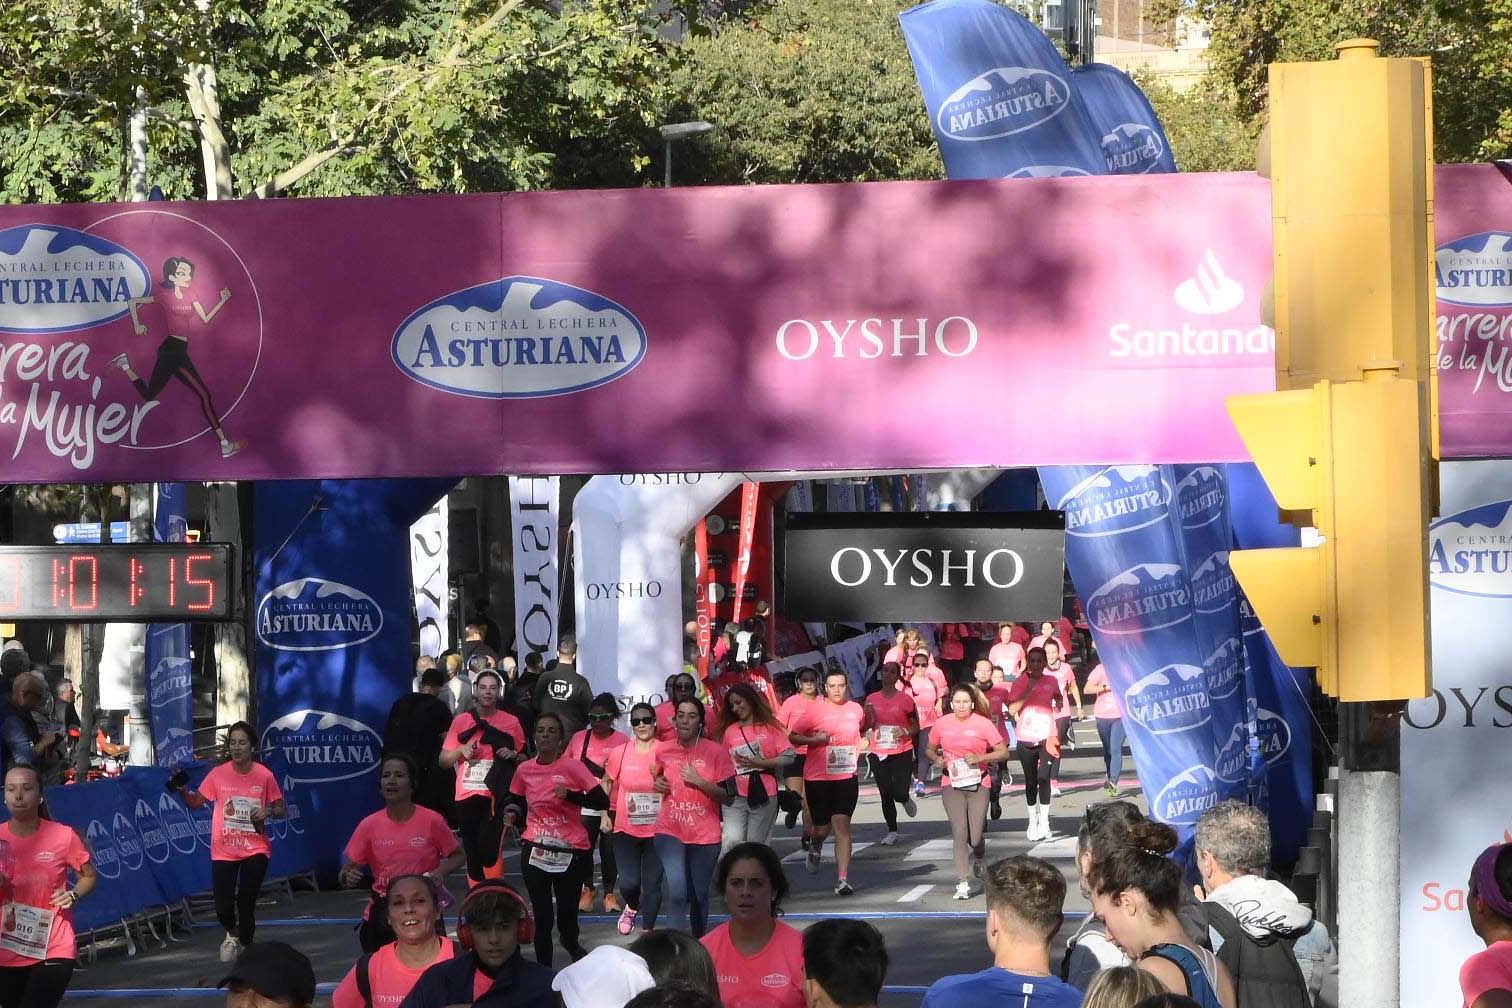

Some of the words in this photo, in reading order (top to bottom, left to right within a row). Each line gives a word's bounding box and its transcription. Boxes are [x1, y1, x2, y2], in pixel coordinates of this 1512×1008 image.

[54, 261, 125, 272] LECHERA
[451, 319, 529, 333] CENTRAL
[538, 317, 617, 330] LECHERA
[411, 323, 626, 368] ASTURIANA
[776, 316, 979, 360] OYSHO
[1459, 343, 1477, 369] la
[12, 376, 160, 469] Mujer
[830, 547, 1024, 588] OYSHO
[586, 580, 662, 600] OYSHO
[322, 602, 370, 611] LECHERA
[261, 604, 374, 635] ASTURIANA
[323, 734, 371, 742] LECHERA
[17, 923, 33, 933] 016
